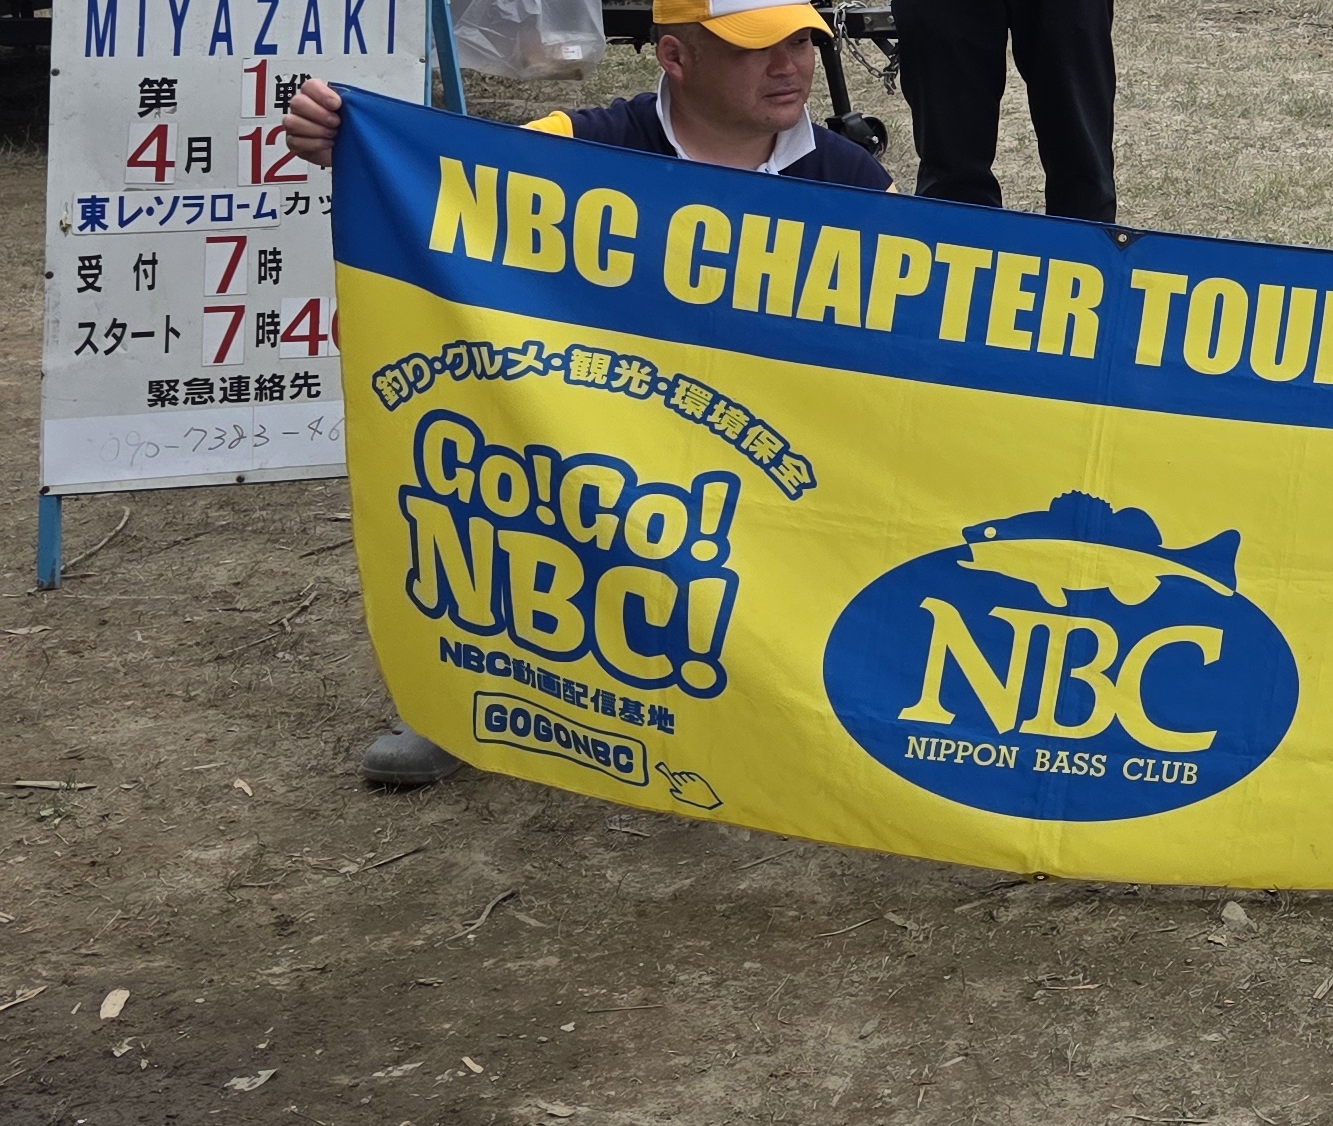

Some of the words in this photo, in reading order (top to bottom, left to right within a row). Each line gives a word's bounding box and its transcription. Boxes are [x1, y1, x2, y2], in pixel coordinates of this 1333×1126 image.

[428, 155, 638, 288] NBC
[663, 203, 1106, 360] CHAPTER
[74, 315, 182, 356] スタート
[147, 371, 322, 408] 緊急連絡先
[402, 489, 737, 696] NBC!
[439, 637, 676, 735] NBC動画配信基地
[897, 596, 1224, 753] NBC
[484, 703, 635, 774] GOGONBC
[904, 735, 1019, 769] NIPPON
[1033, 749, 1107, 778] BASS
[1122, 756, 1199, 786] CLUB
